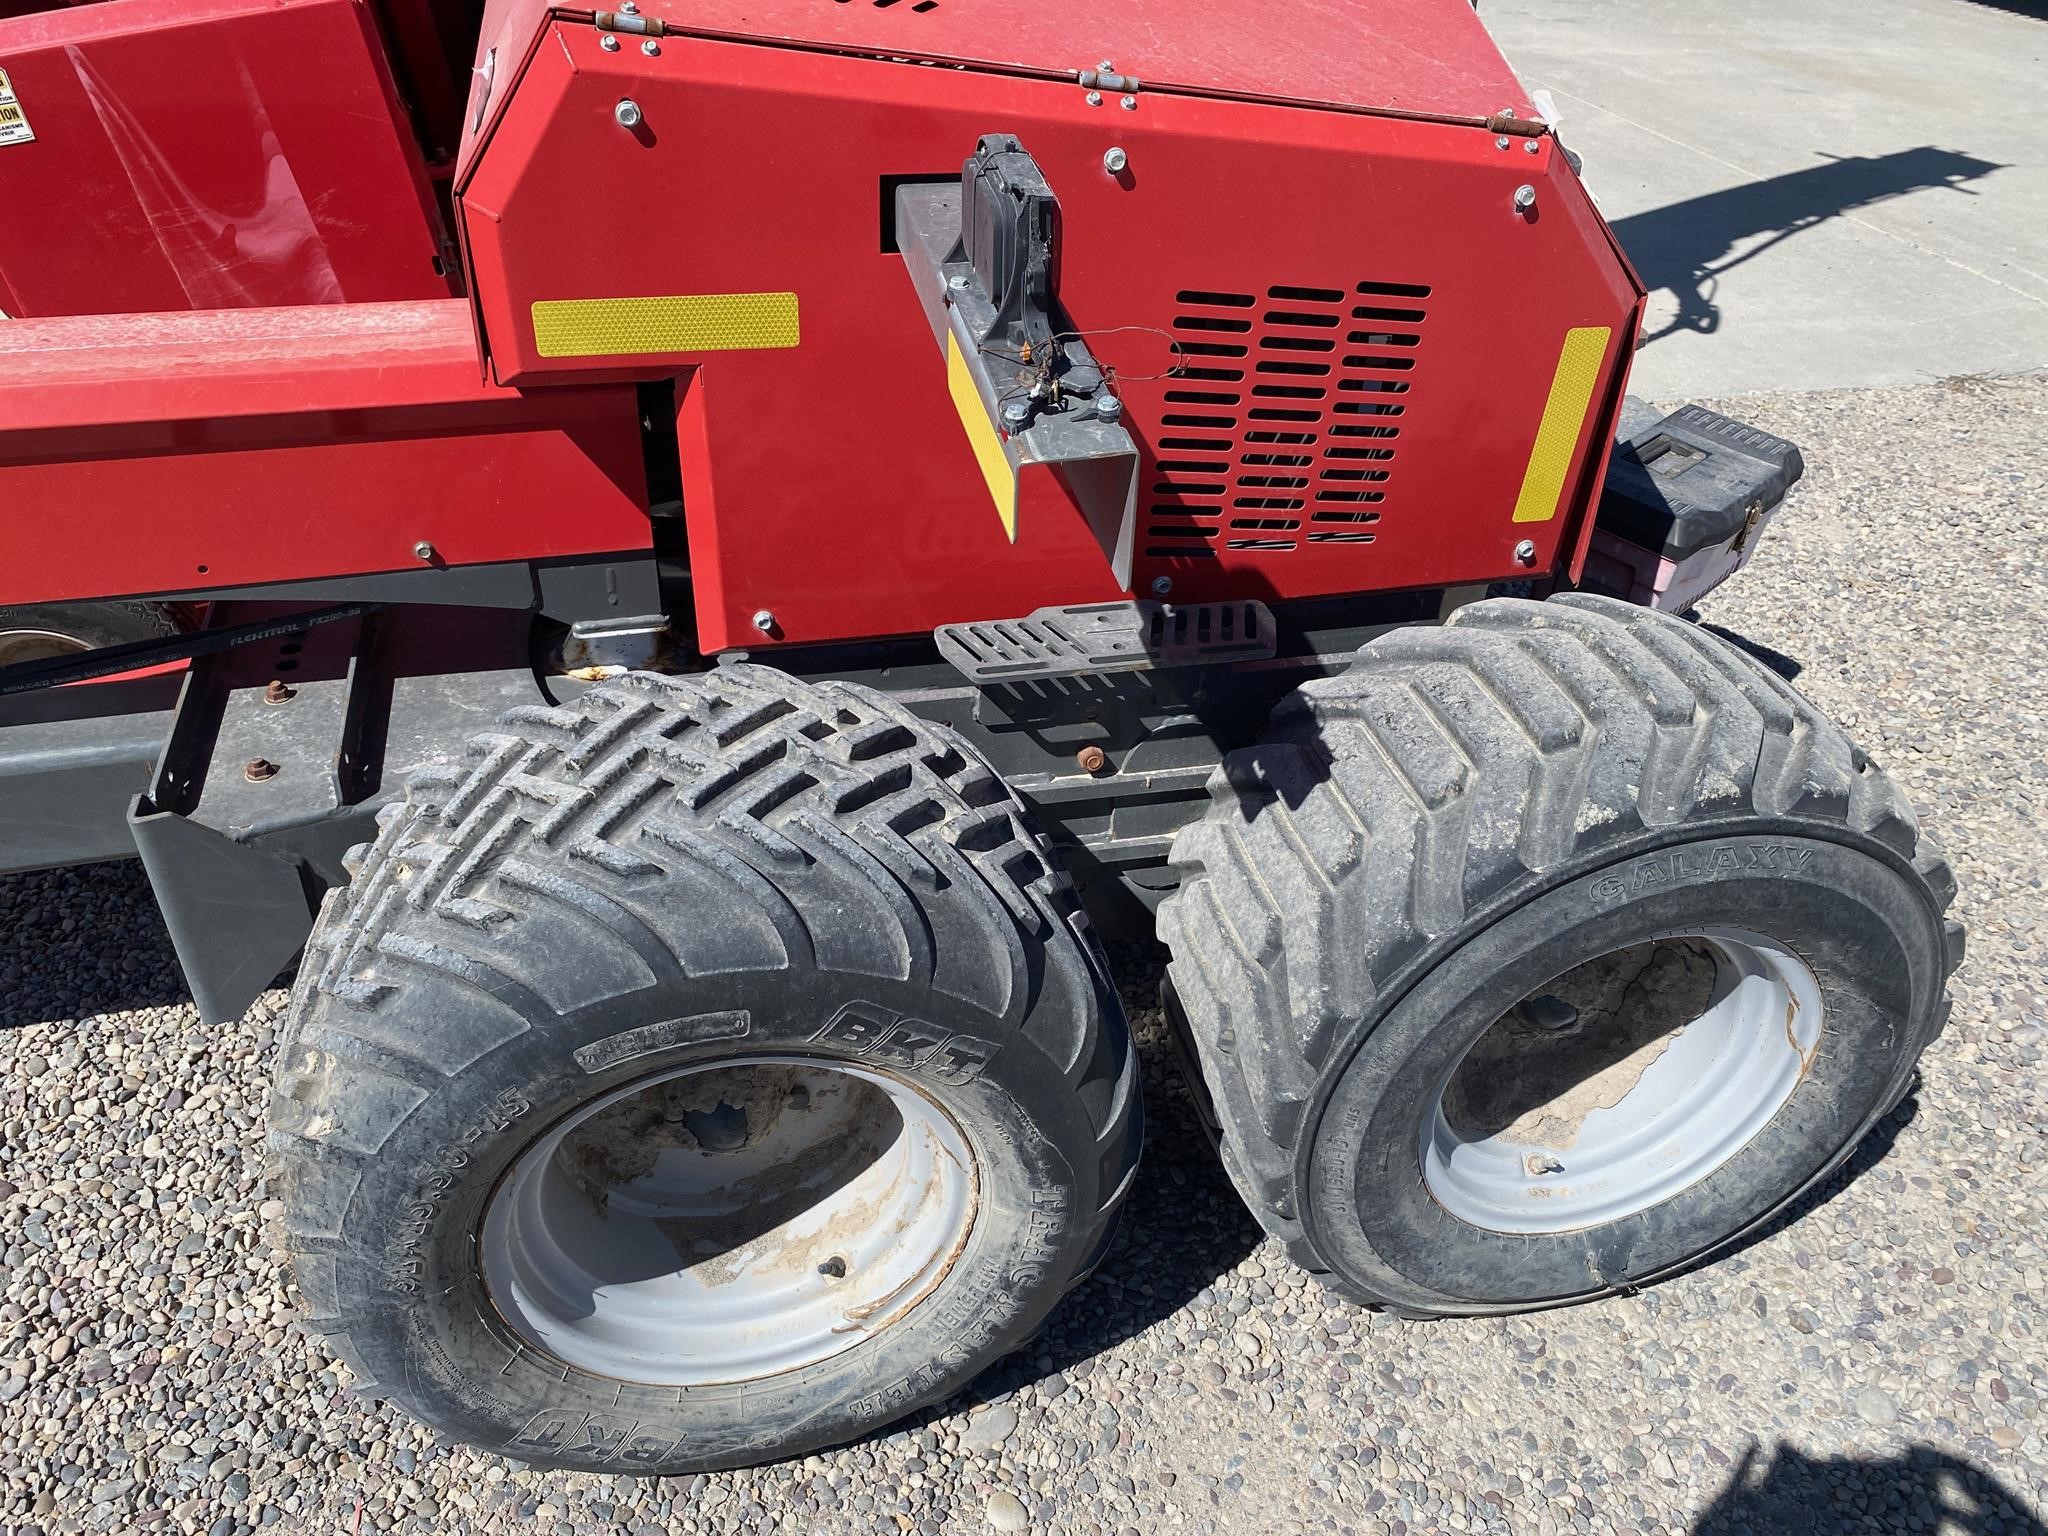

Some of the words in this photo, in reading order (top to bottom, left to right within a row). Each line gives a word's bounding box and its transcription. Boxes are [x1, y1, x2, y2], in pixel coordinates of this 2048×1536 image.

[0, 107, 20, 121] ION
[1589, 844, 1815, 903] GALAXY
[815, 1005, 993, 1081] BKT
[1009, 1183, 1069, 1289] TRAC
[930, 1255, 1002, 1344] IMPLEMENT
[848, 1290, 1025, 1424] MASTER
[511, 1413, 683, 1465] BKT
